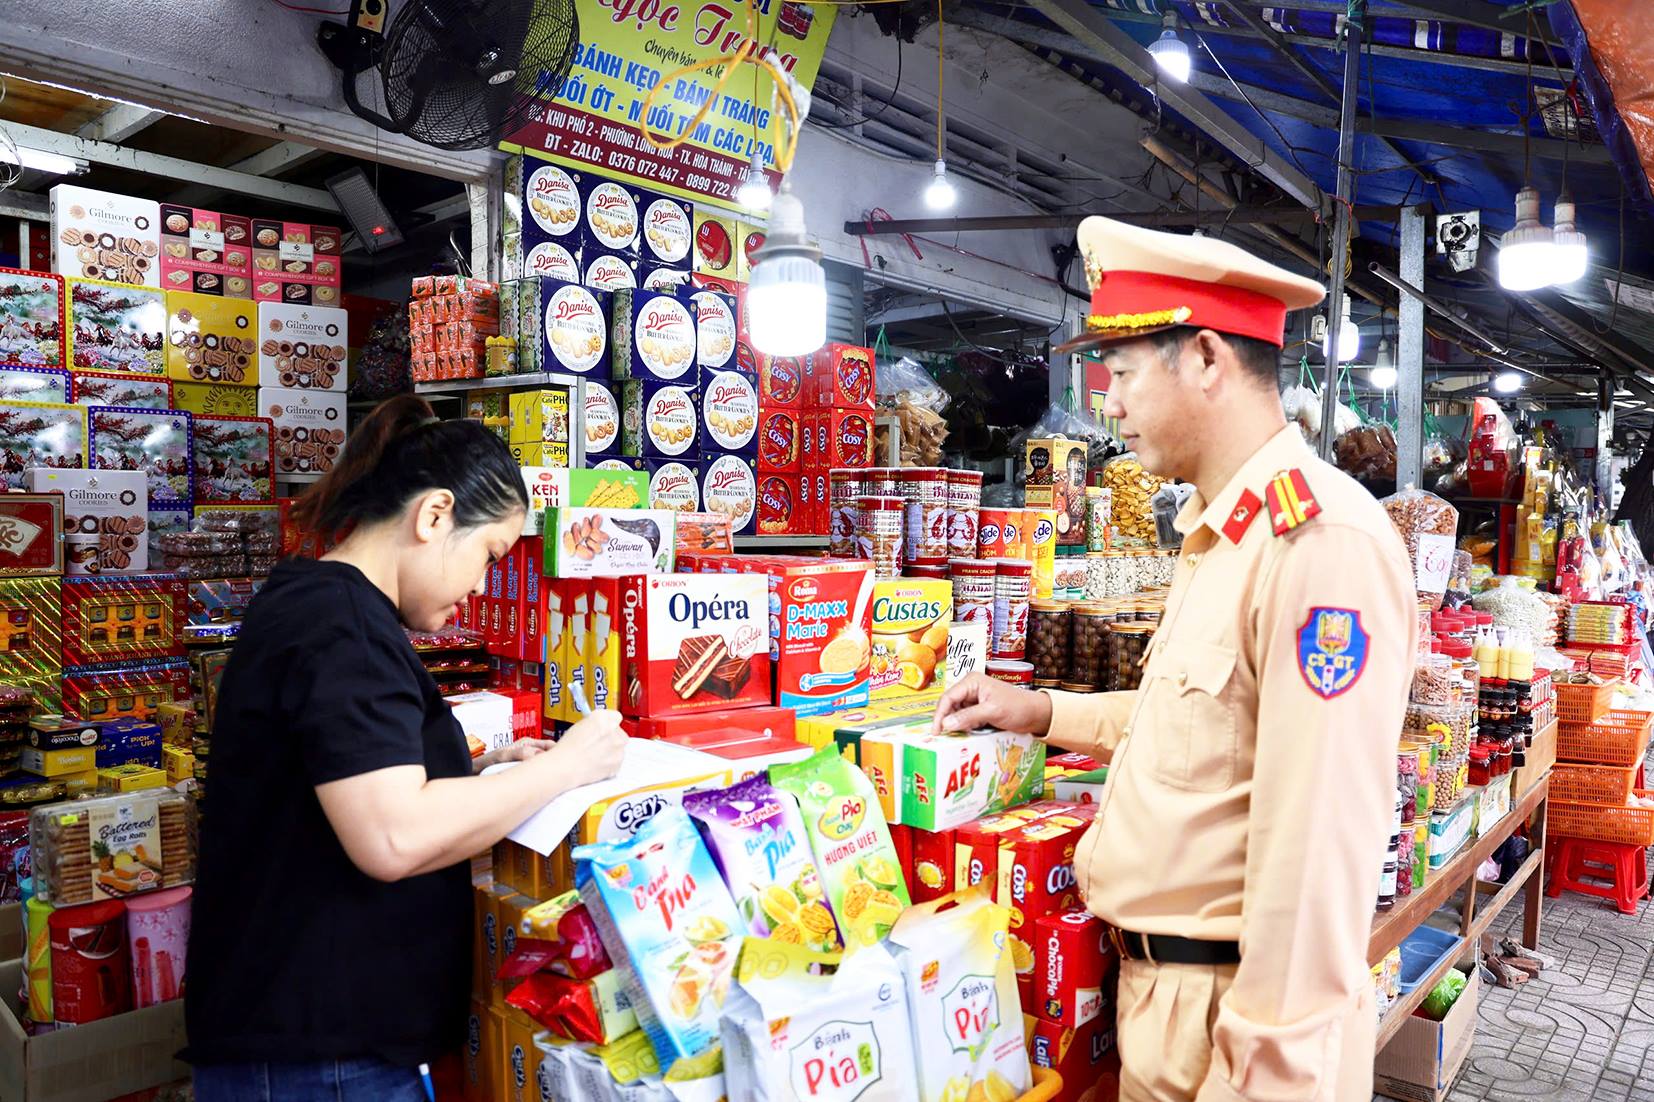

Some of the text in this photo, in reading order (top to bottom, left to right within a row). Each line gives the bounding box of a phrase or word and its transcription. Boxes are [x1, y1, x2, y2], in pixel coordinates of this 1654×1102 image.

[598, 0, 680, 31] gọc
[644, 39, 679, 64] Chuyên
[705, 67, 713, 76] &
[571, 42, 624, 80] BÁNH
[624, 61, 661, 93] KẸO
[673, 79, 720, 112] BÁNH
[721, 95, 770, 130] TRÁNG
[589, 83, 616, 113] ỚT
[628, 99, 675, 133] MUỐI
[712, 127, 745, 154] CÁC
[546, 109, 565, 129] KHU
[566, 113, 587, 134] PHỐ
[586, 121, 594, 136] 2
[599, 124, 635, 149] PHƯỜNG
[635, 135, 657, 155] LONG
[680, 149, 692, 166] TX.
[691, 151, 709, 171] HÒA
[709, 159, 733, 177] THÀNH
[544, 133, 562, 150] ĐT
[570, 140, 604, 164] ZALO:
[608, 150, 636, 172] 0376
[637, 158, 656, 178] 072
[658, 165, 681, 183] 447
[685, 172, 711, 193] 0899
[713, 179, 733, 198] 722
[535, 177, 570, 193] Danisa
[595, 193, 629, 209] Danisa
[88, 207, 133, 223] Gilmore
[652, 209, 682, 224] Danisa
[700, 226, 710, 235] LU
[534, 253, 570, 270] Danisa
[594, 266, 628, 283] Danisa
[555, 300, 596, 320] Danisa
[285, 319, 324, 331] Gilmore
[645, 311, 683, 330] Danisa
[771, 366, 791, 383] COSY
[844, 367, 861, 389] COSY
[586, 392, 609, 409] anisa
[712, 384, 749, 403] Danisa
[285, 404, 323, 416] Gilmore
[654, 397, 688, 415] Danisa
[768, 430, 788, 449] COSY
[802, 426, 812, 454] COSY
[817, 425, 826, 454] COSY
[842, 433, 863, 445] COSY
[657, 473, 690, 493] Danisa
[711, 467, 747, 488] Danisa
[69, 488, 117, 501] Gilmore
[532, 484, 559, 496] KEN
[800, 476, 809, 504] COSY
[816, 475, 825, 503] COSY
[762, 493, 783, 511] COSY
[607, 537, 644, 553] Sanwan
[660, 580, 688, 588] ORION
[793, 586, 818, 597] Roma
[901, 589, 923, 597] ORION
[668, 592, 751, 630] Opéra
[787, 600, 848, 622] D-MAXX
[873, 597, 941, 622] Custas
[622, 588, 639, 659] Opéra
[786, 620, 828, 641] Marie
[953, 653, 976, 678] Joy
[1308, 653, 1355, 670] CS GT
[549, 662, 562, 707] Tipo
[130, 735, 150, 743] PICK
[872, 766, 888, 797] AFC
[943, 752, 981, 799] AFC
[914, 772, 930, 804] AFC
[615, 795, 662, 830] Gery
[112, 831, 147, 843] Egg Rolls
[824, 841, 856, 865] HƯƠNG
[1012, 863, 1027, 904] COSY
[961, 981, 989, 999] Bánh
[814, 1027, 851, 1051] Bánh
